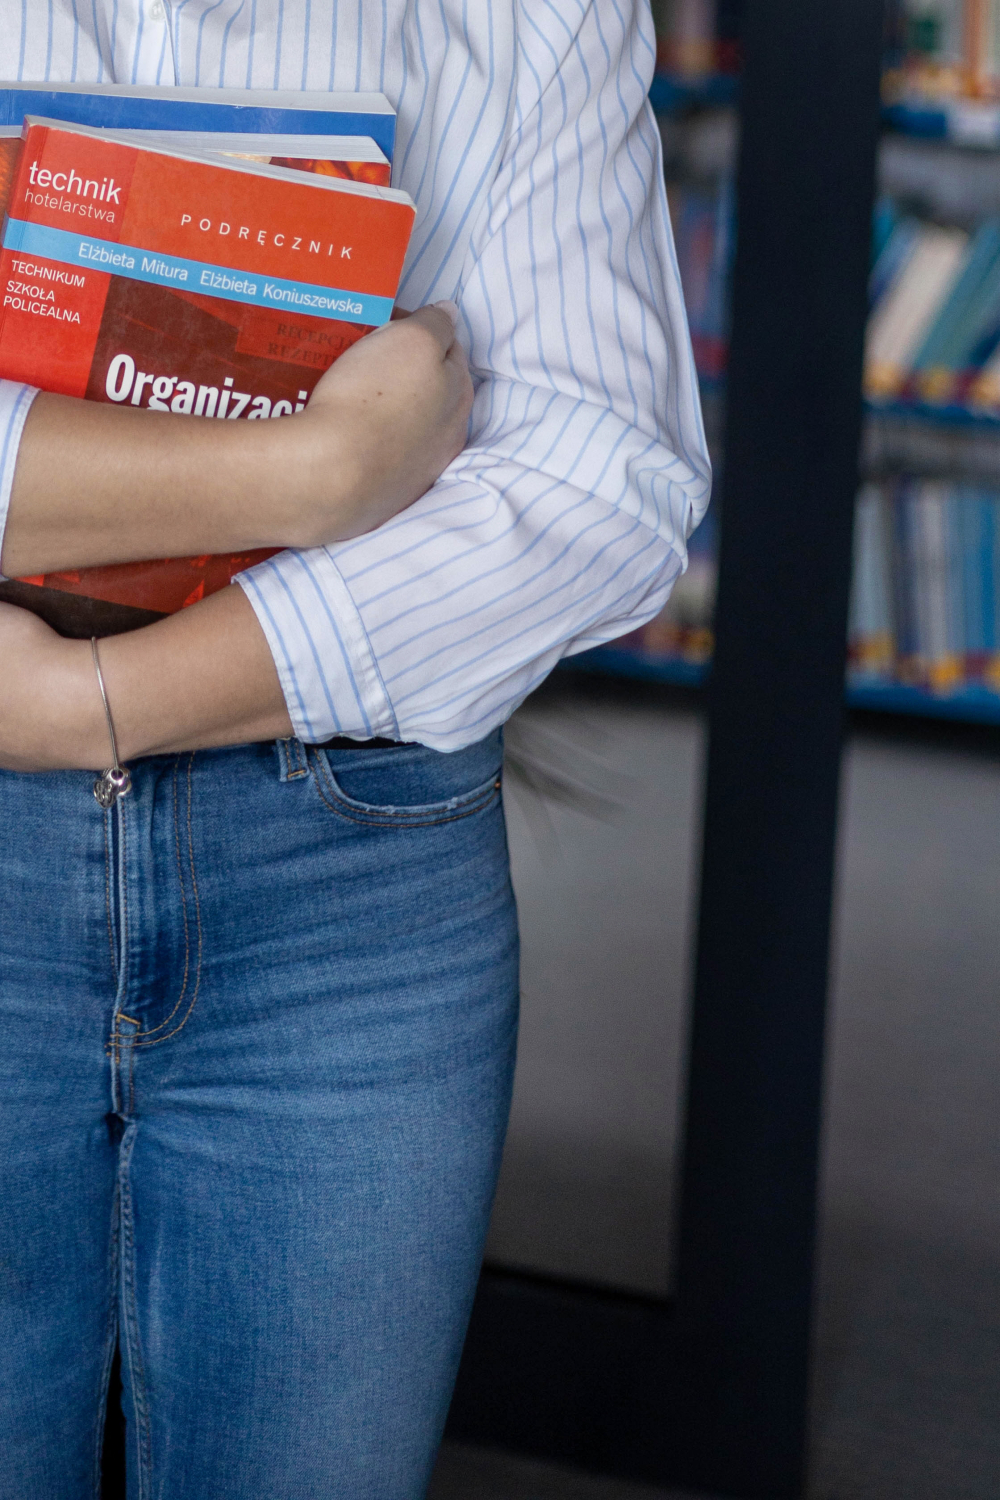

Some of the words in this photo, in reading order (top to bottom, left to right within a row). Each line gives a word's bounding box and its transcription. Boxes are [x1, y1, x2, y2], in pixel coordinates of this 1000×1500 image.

[29, 161, 122, 204] technik
[24, 189, 116, 223] hotelarstwa
[180, 214, 353, 260] PODRĘCZNIK
[6, 280, 55, 302] SZKOŁA
[11, 260, 85, 288] TECHNIKUM
[78, 242, 136, 269] Elżbieta
[141, 257, 189, 282] Mitura
[200, 270, 258, 296] Elżbieta
[263, 283, 364, 315] Koniuszewska
[3, 296, 81, 324] POLICEALNA
